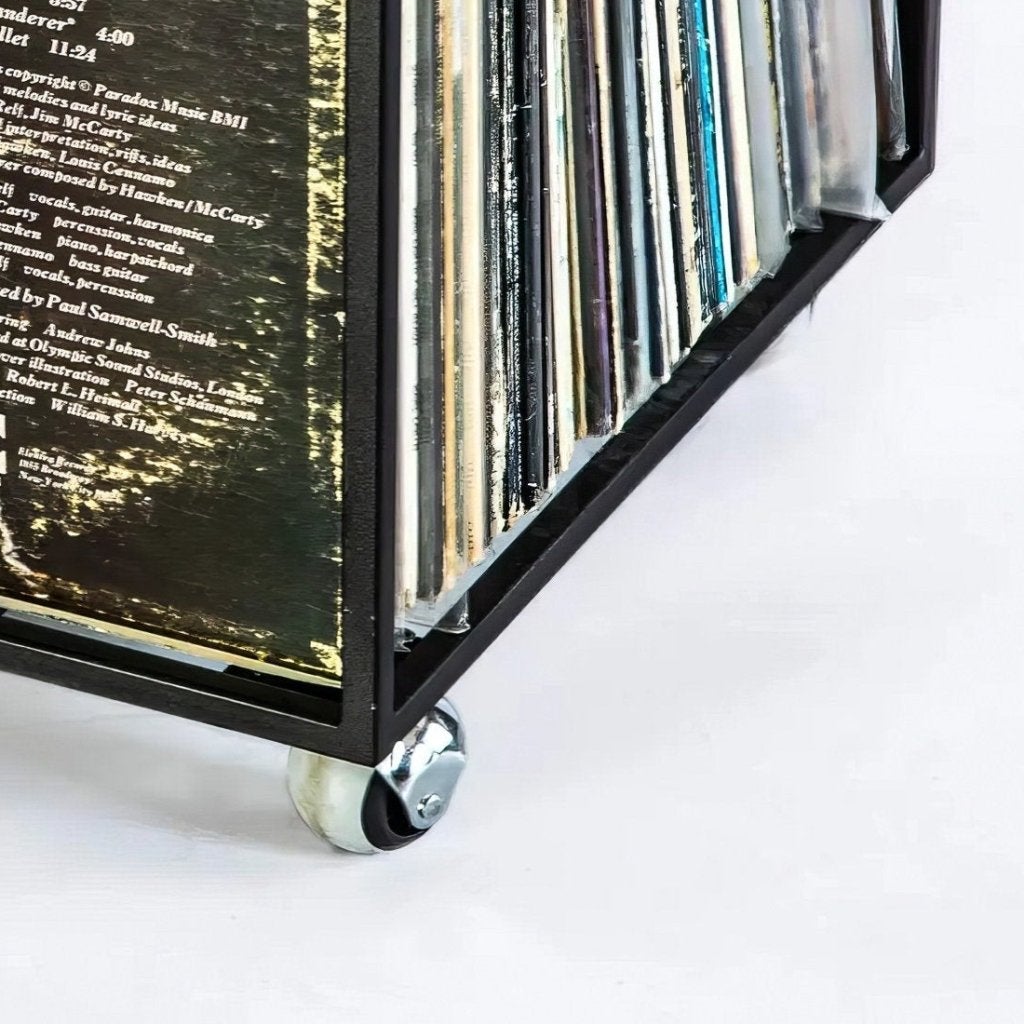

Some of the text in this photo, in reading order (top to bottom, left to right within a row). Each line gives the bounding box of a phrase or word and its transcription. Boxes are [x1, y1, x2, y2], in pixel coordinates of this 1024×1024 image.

[95, 27, 135, 46] 4:00
[48, 39, 97, 63] 11:24
[3, 86, 69, 108] melodies
[69, 101, 100, 115] and
[100, 104, 138, 124] lyric
[138, 113, 178, 133] ideas
[5, 67, 77, 90] copyright
[93, 83, 160, 110] Paradox
[160, 98, 210, 121] Music
[210, 110, 249, 130] BMI
[30, 107, 60, 124] Jim
[62, 114, 133, 143] McCarty
[58, 150, 102, 172] Louis
[152, 154, 193, 174] ideas
[23, 165, 98, 189] composed
[98, 178, 119, 195] by
[132, 213, 215, 244] harmonica
[104, 244, 195, 276] harpsichord
[137, 237, 185, 255] vocals
[69, 254, 101, 273] bass
[102, 266, 150, 283] guitar
[22, 288, 45, 308] by
[46, 293, 87, 316] Paul
[75, 277, 156, 304] percussion
[43, 323, 106, 348] Andrew
[105, 338, 152, 360] Johns
[11, 337, 28, 348] at
[29, 338, 95, 365] Olympic
[94, 354, 144, 376] Sound
[6, 368, 59, 393] Robert
[124, 379, 168, 400] Peter
[51, 398, 111, 424] William
